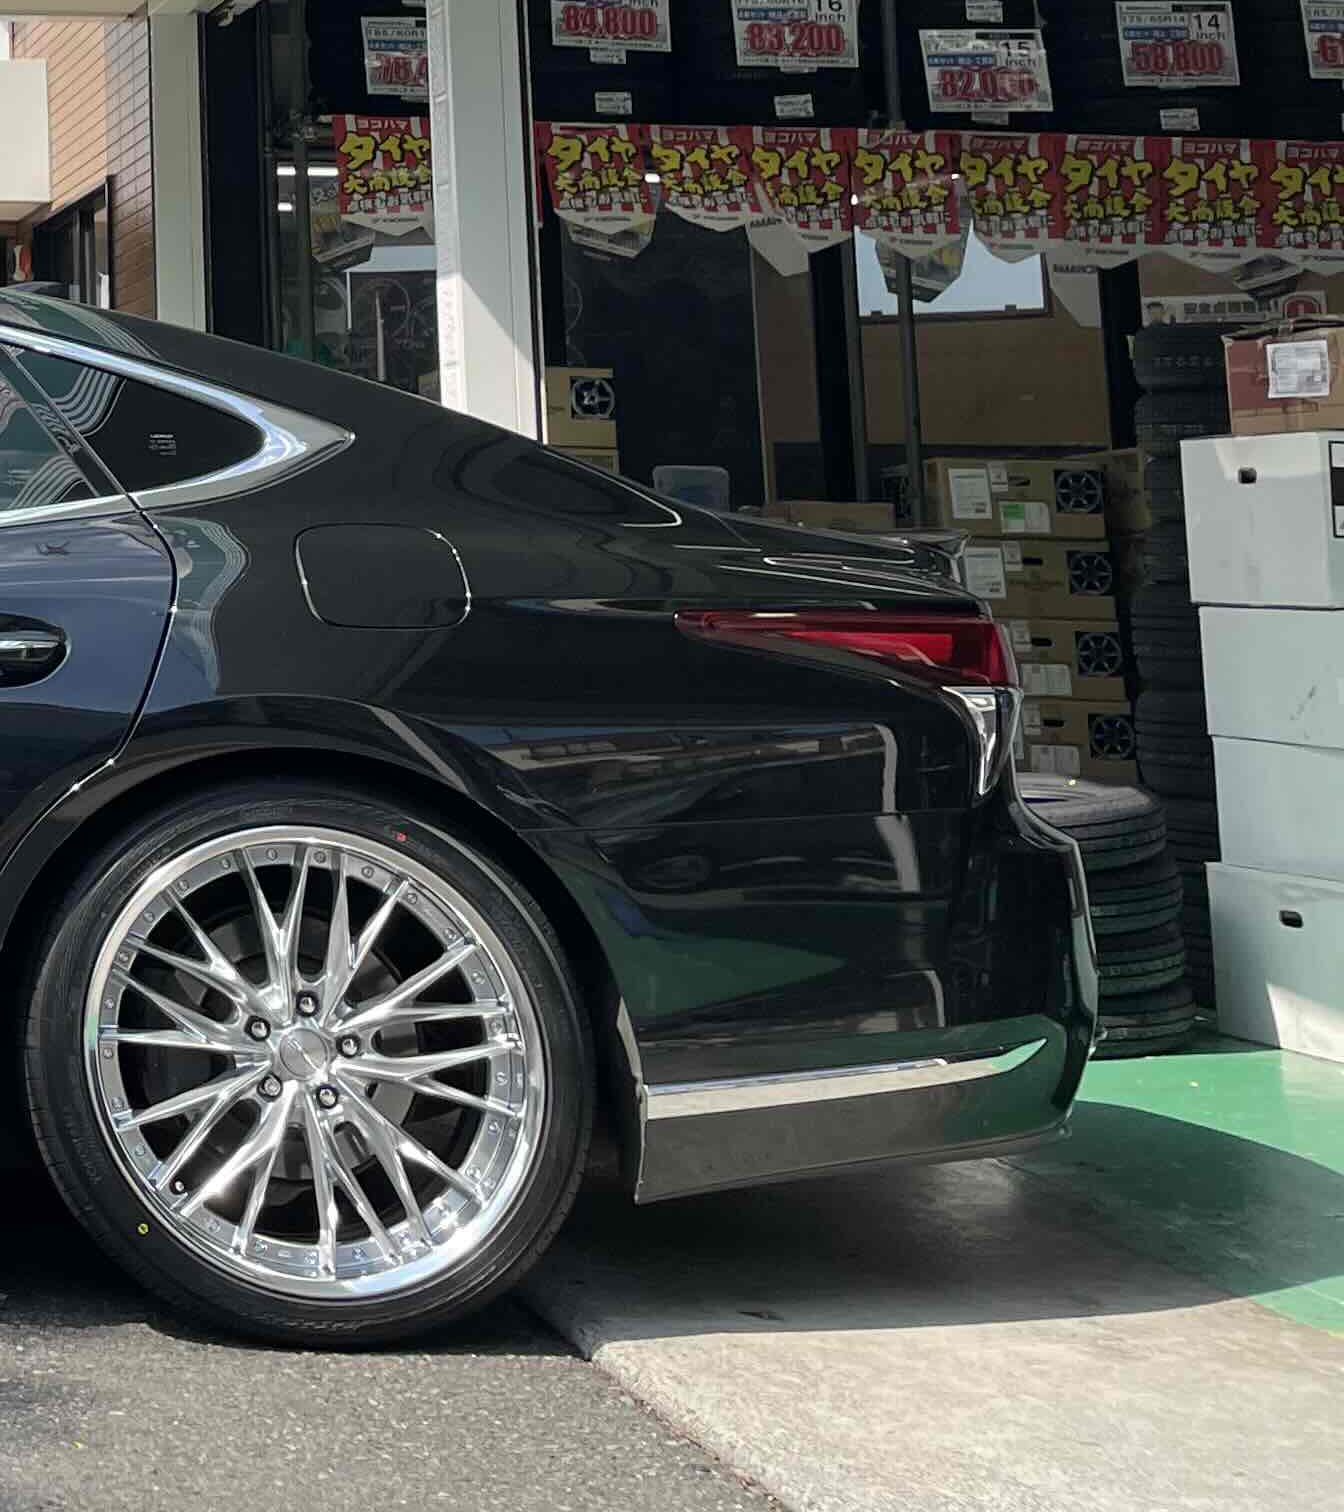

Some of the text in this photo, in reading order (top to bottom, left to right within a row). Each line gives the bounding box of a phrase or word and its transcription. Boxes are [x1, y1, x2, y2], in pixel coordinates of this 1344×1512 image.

[1193, 13, 1221, 30] 14
[544, 135, 638, 172] タイヤ
[651, 143, 740, 173] タイヤ
[752, 146, 842, 180] タイヤ
[854, 150, 946, 185] タイヤ
[959, 151, 1050, 186] タイヤ
[1061, 152, 1153, 194] タイヤ
[1163, 157, 1260, 198] タイヤ
